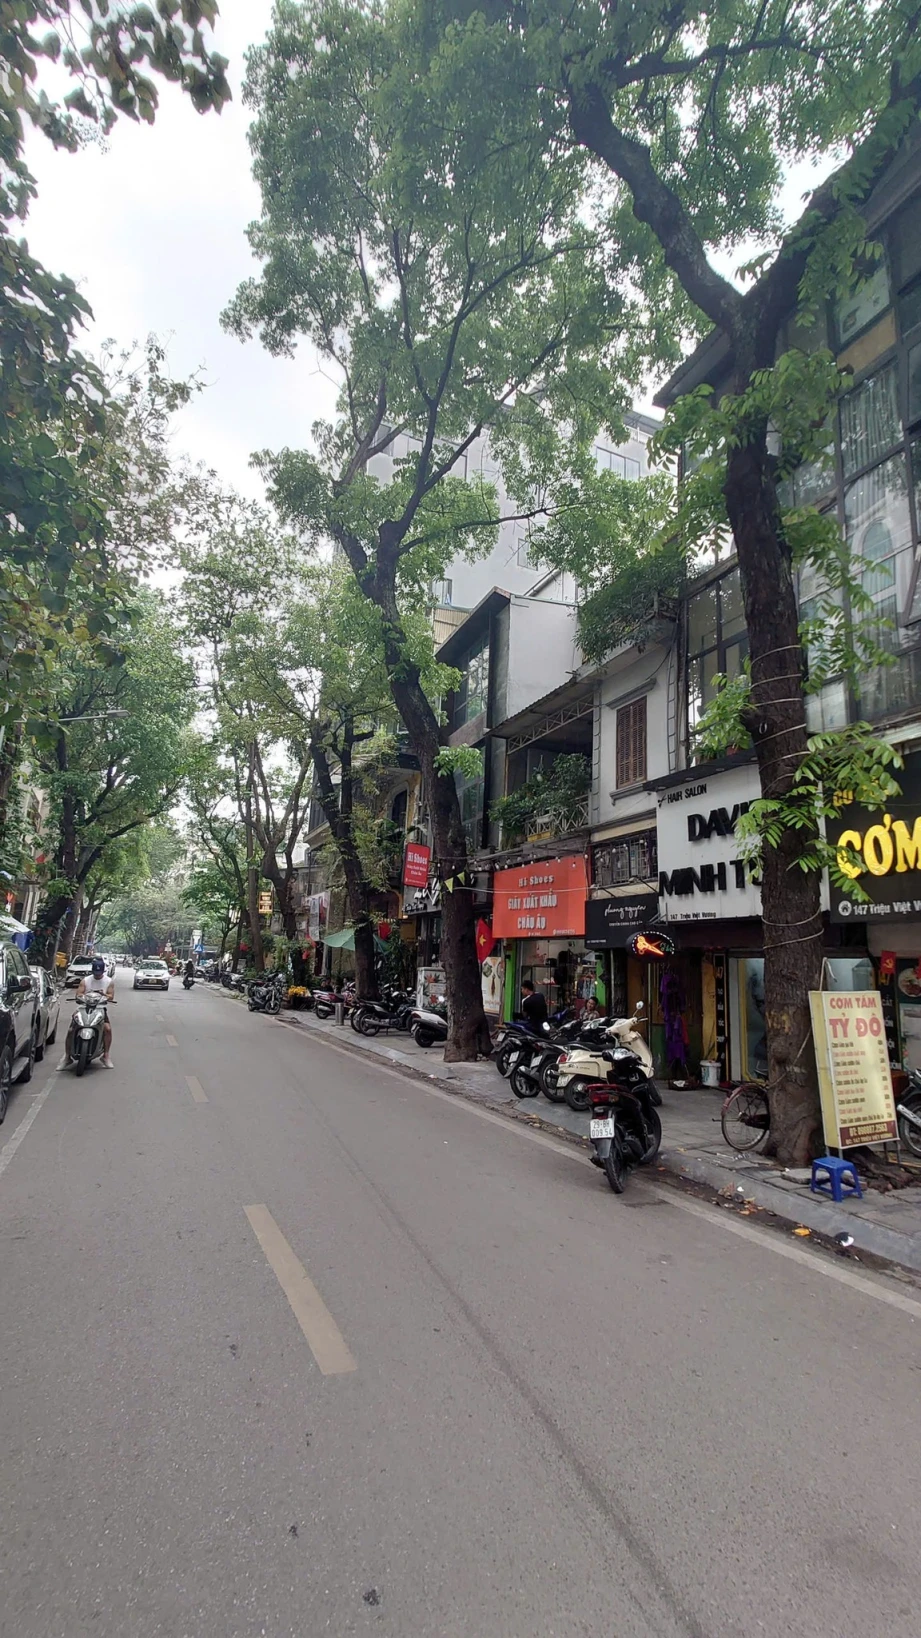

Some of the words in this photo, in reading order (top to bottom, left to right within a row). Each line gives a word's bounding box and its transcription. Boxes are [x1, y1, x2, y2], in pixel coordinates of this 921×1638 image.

[667, 790, 683, 804] HAIR
[685, 783, 707, 799] SALON
[529, 875, 554, 885] Shoes
[853, 904, 868, 915] 147
[869, 903, 890, 915] Triệu
[893, 901, 911, 914] Việt
[855, 1013, 882, 1038] ĐÔ
